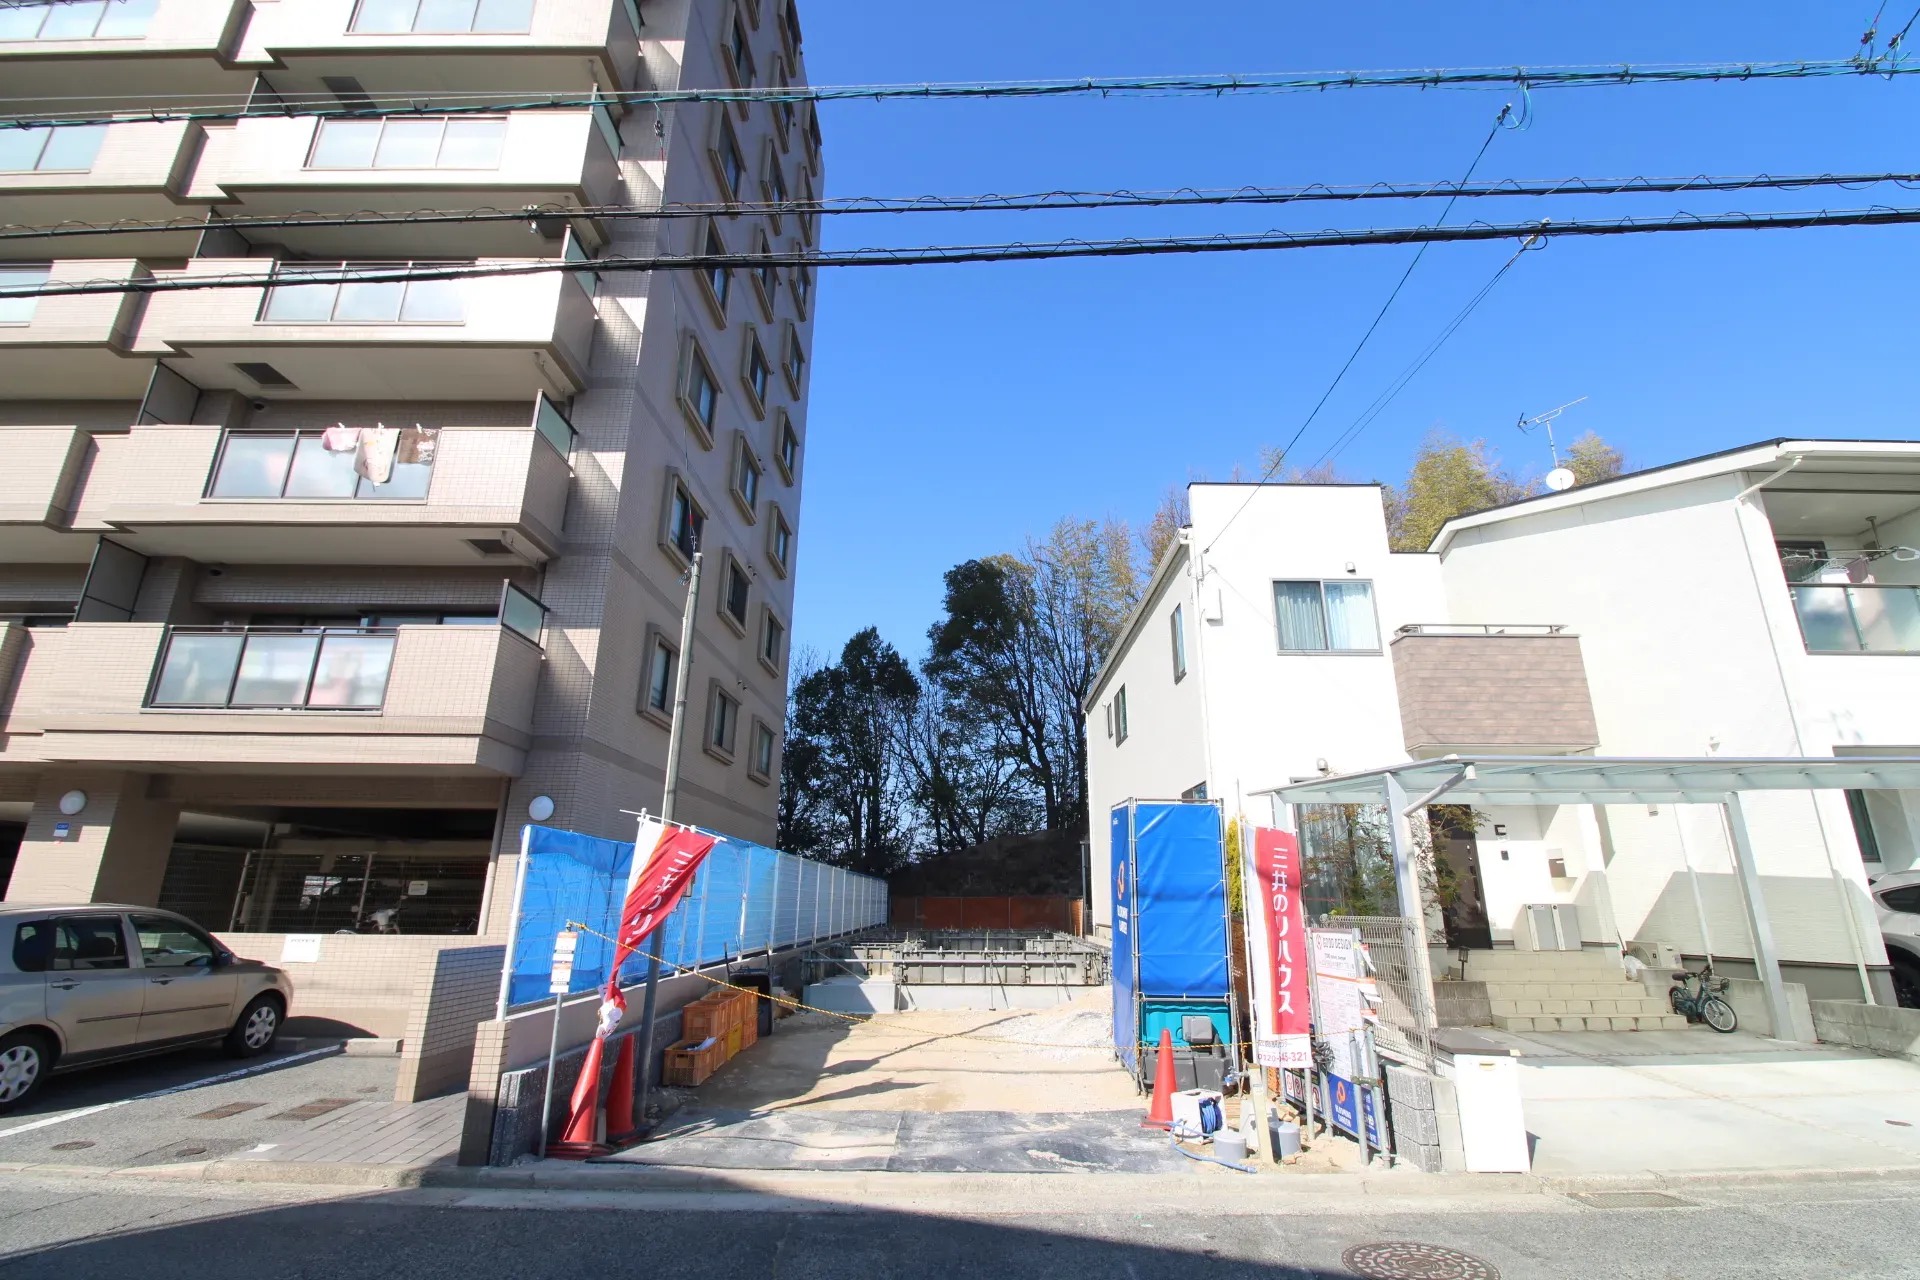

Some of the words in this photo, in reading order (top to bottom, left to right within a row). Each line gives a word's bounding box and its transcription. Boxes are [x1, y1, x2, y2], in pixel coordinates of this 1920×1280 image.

[1271, 847, 1294, 1015] 三井のリハウス
[1334, 938, 1352, 950] DESIGN
